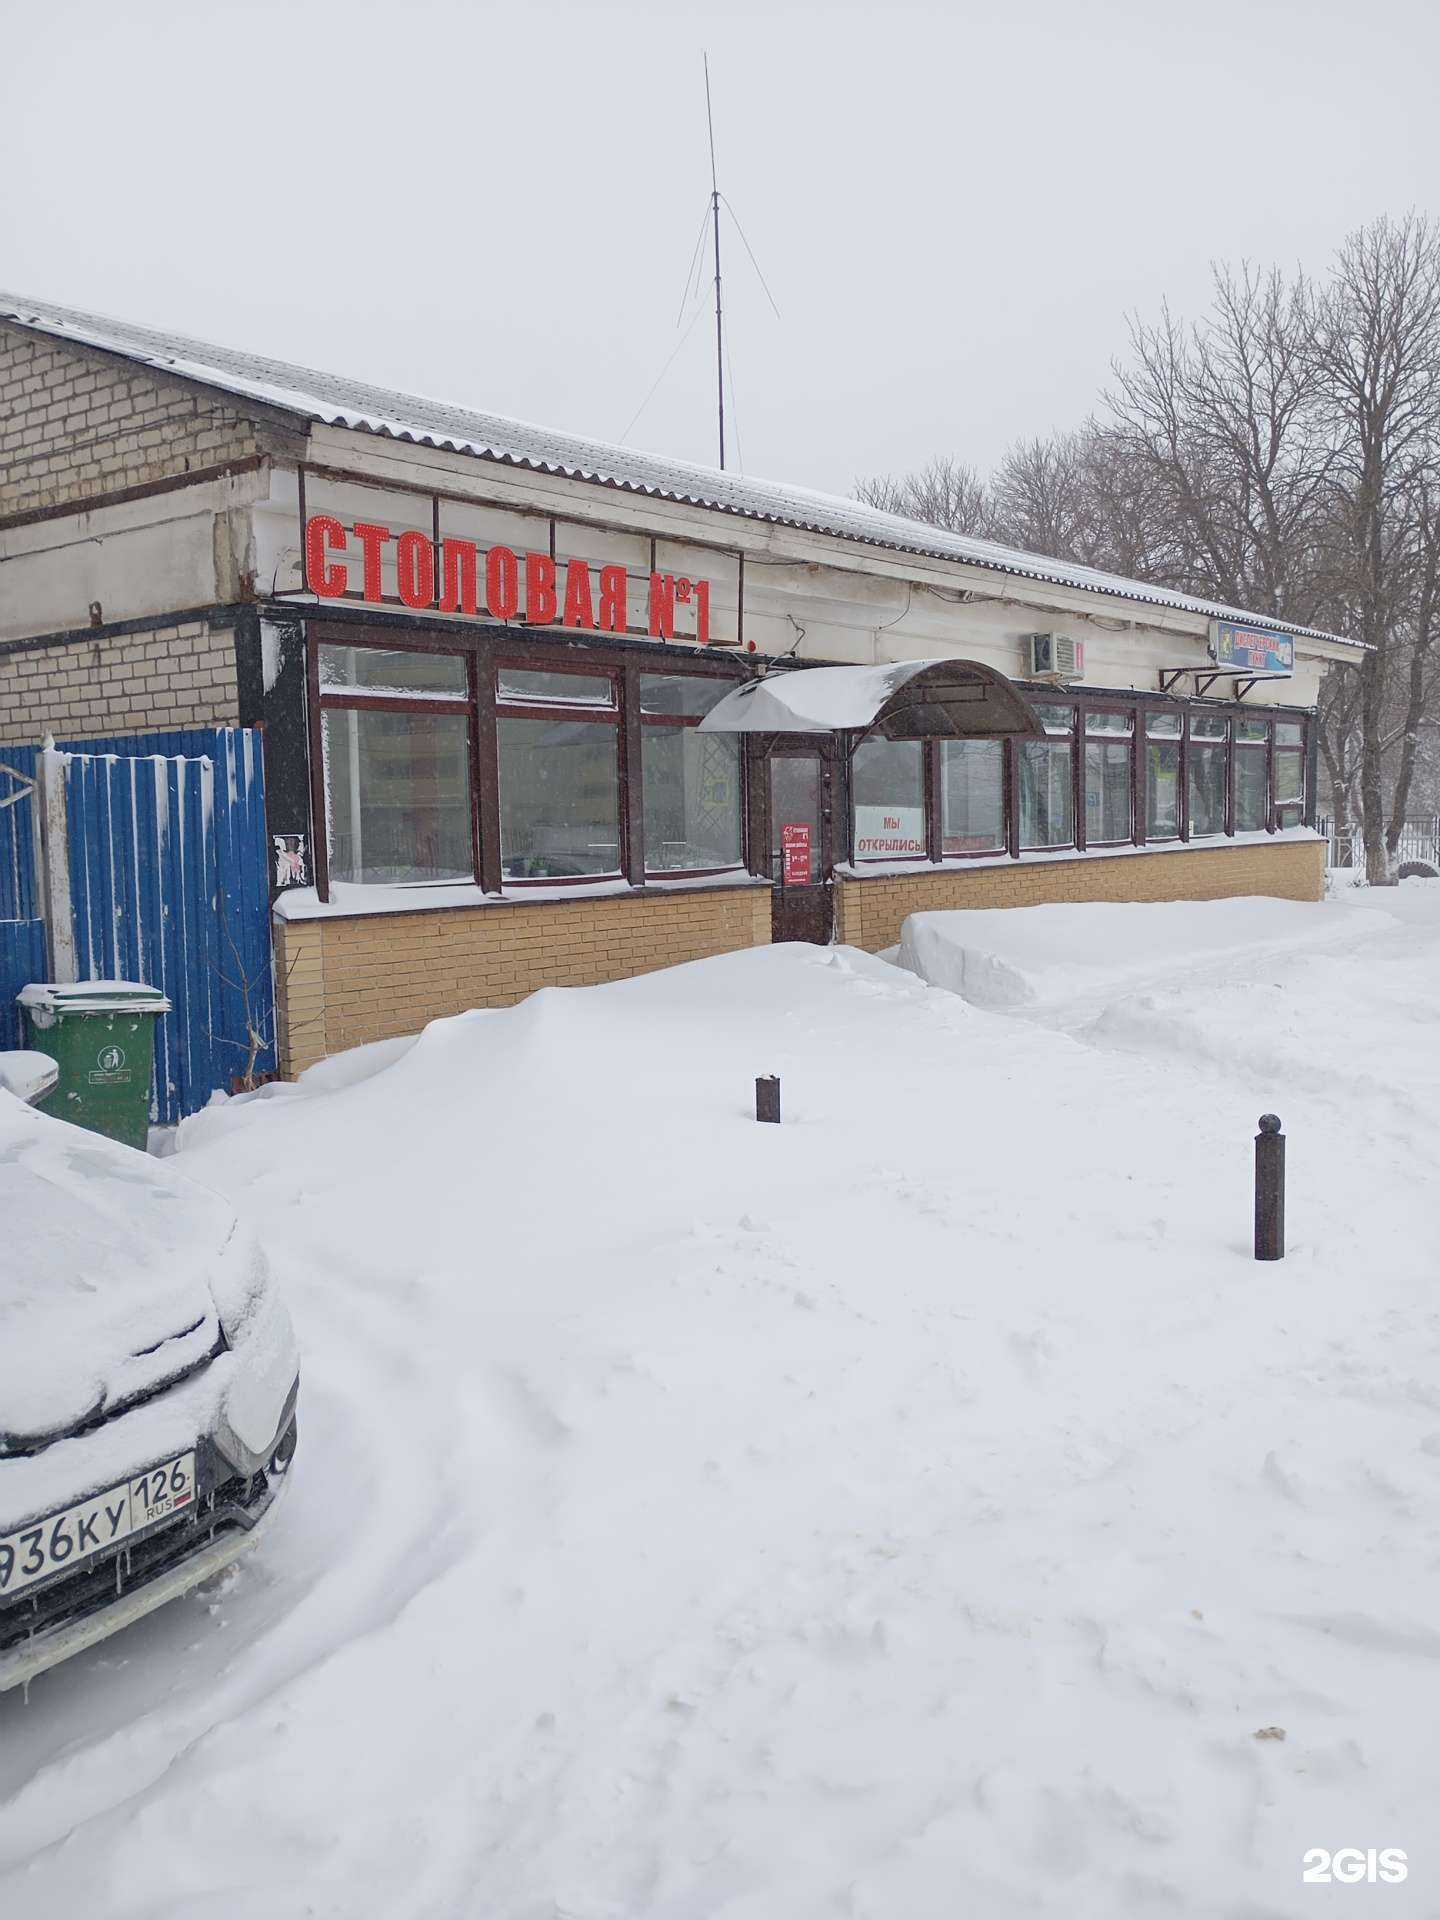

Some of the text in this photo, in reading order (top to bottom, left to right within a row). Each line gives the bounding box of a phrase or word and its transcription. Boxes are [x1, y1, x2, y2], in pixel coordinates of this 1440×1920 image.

[305, 515, 627, 634] СТОЛОВАЯ
[883, 816, 901, 830] МЫ
[858, 838, 921, 852] ОТКРЫЛИСЬ
[134, 1460, 186, 1509] 126
[146, 1499, 173, 1521] RUS
